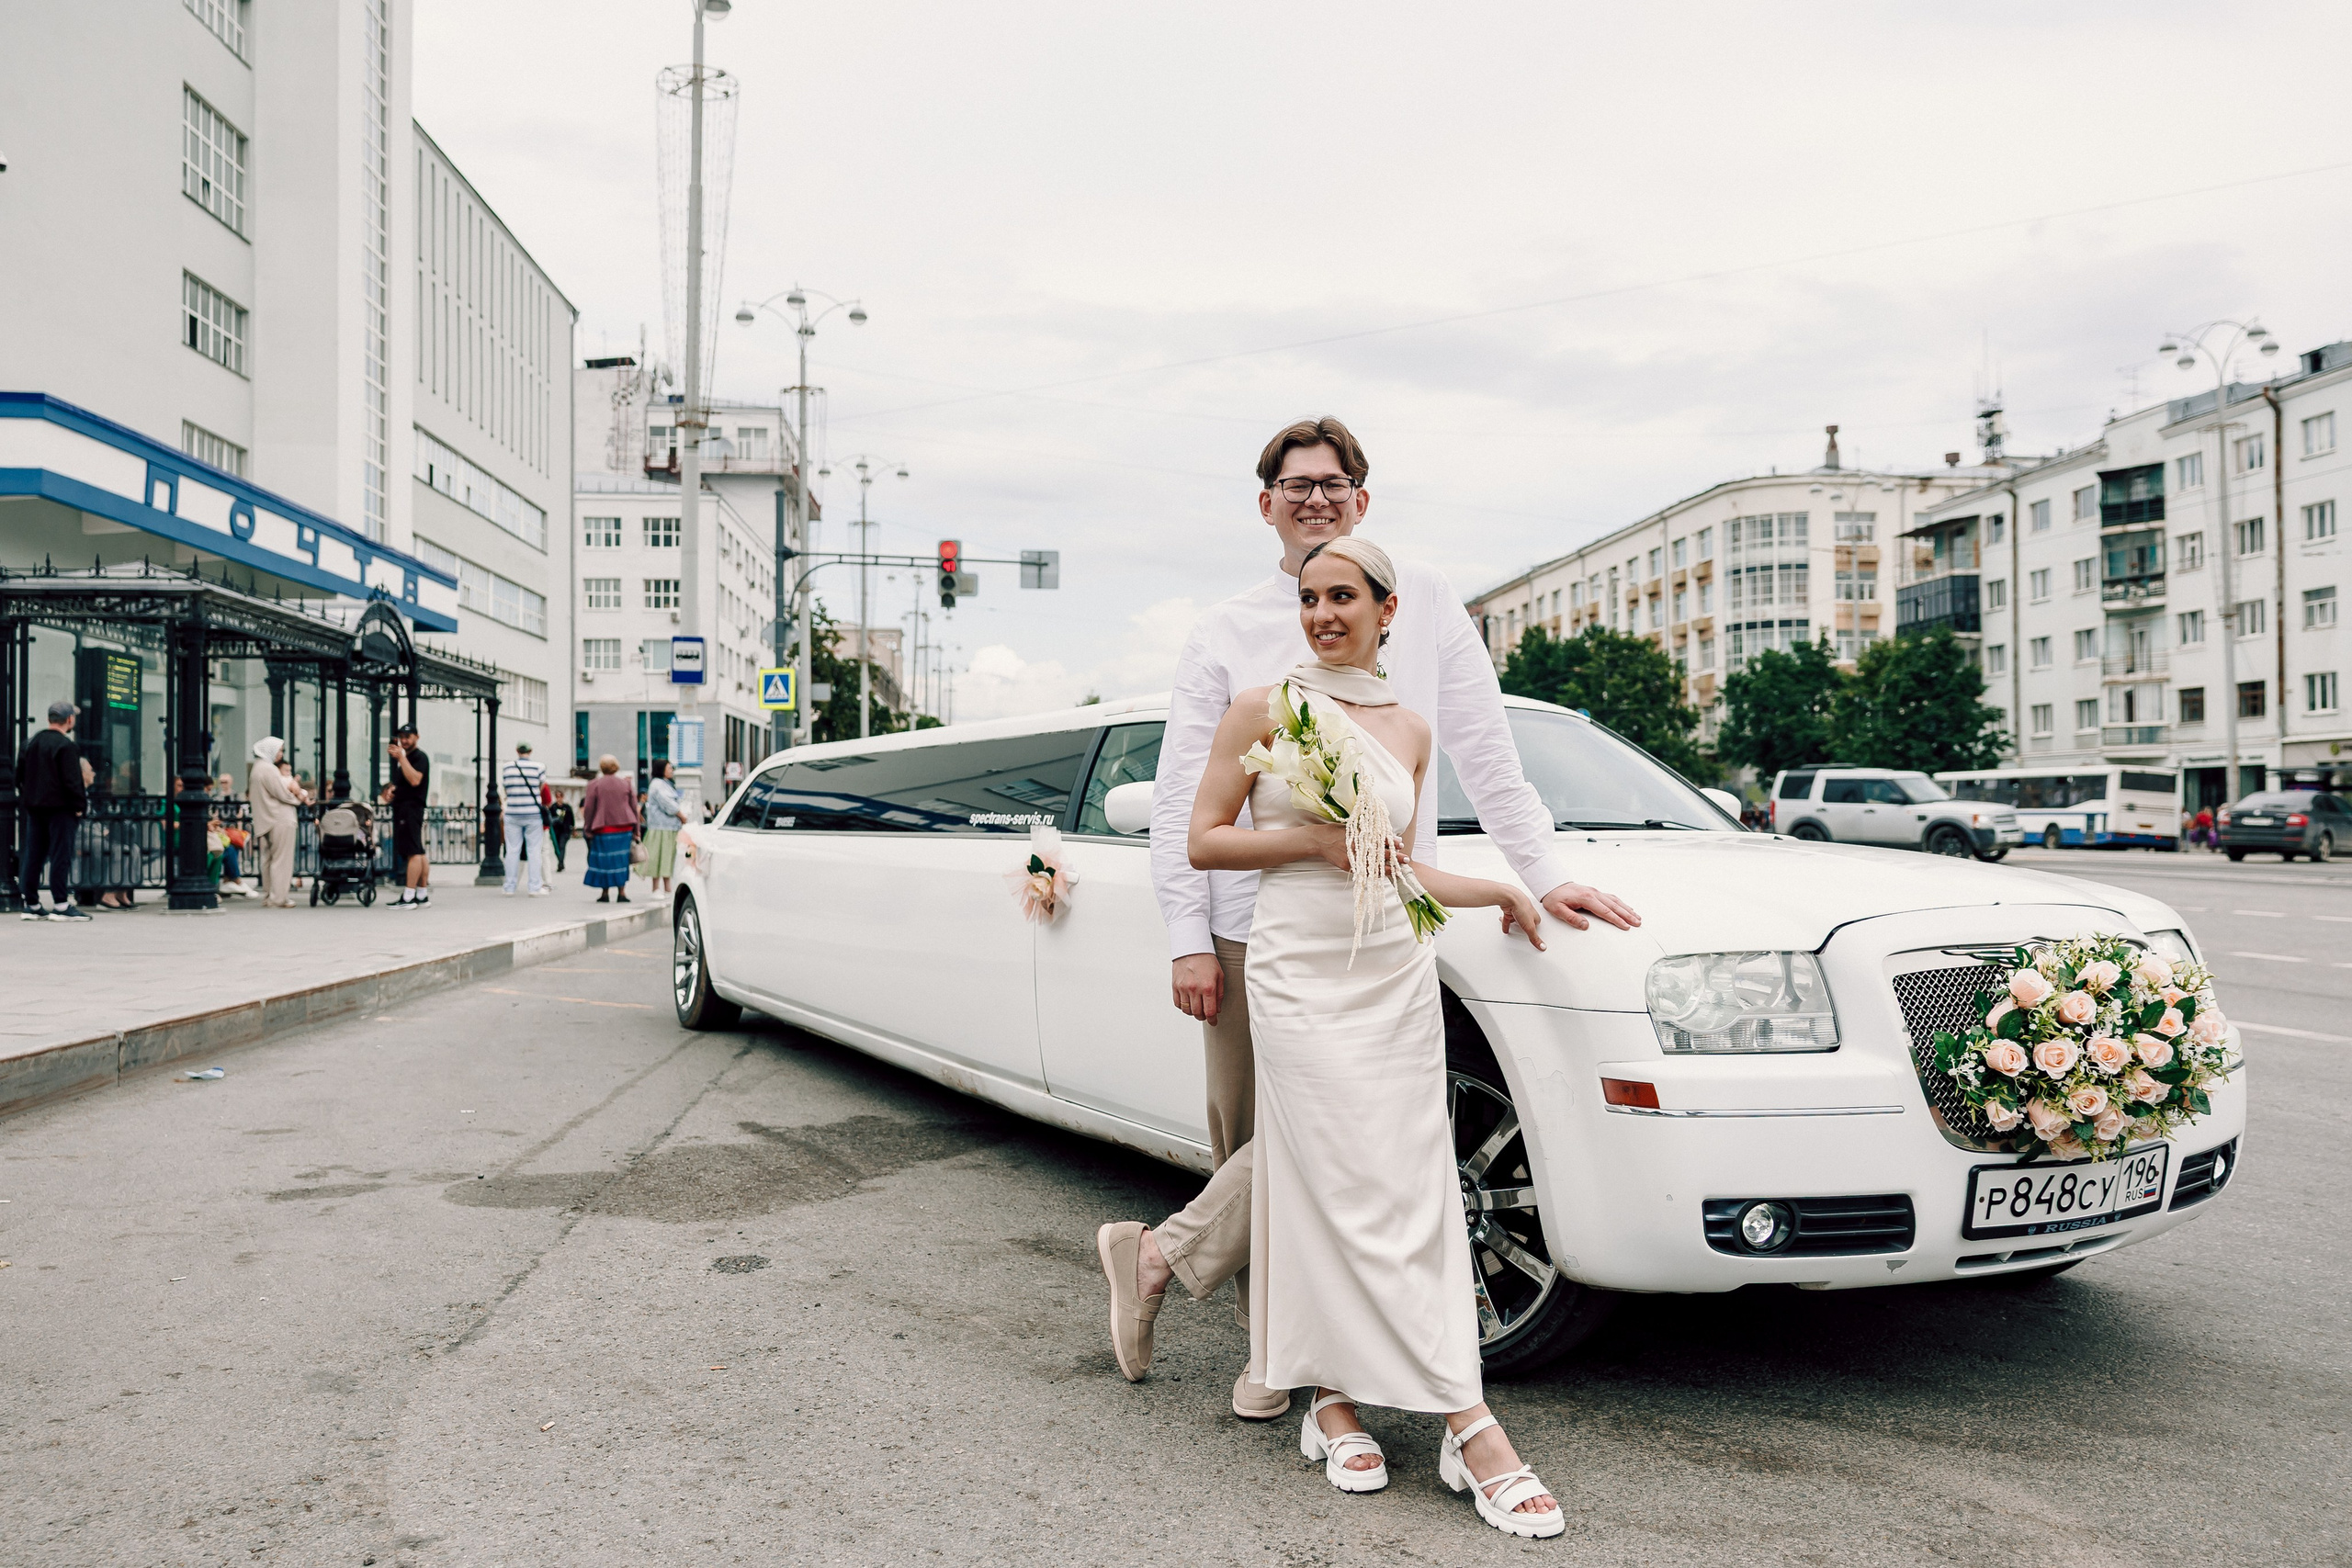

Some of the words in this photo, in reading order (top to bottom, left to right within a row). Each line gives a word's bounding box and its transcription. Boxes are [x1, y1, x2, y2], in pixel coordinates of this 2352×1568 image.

[145, 459, 418, 604] ПОЧТА
[969, 811, 1055, 827] spectrans-servis.ru
[2123, 1154, 2157, 1190] 196
[2125, 1188, 2143, 1202] RUS
[2043, 1216, 2107, 1234] RUSSIA
